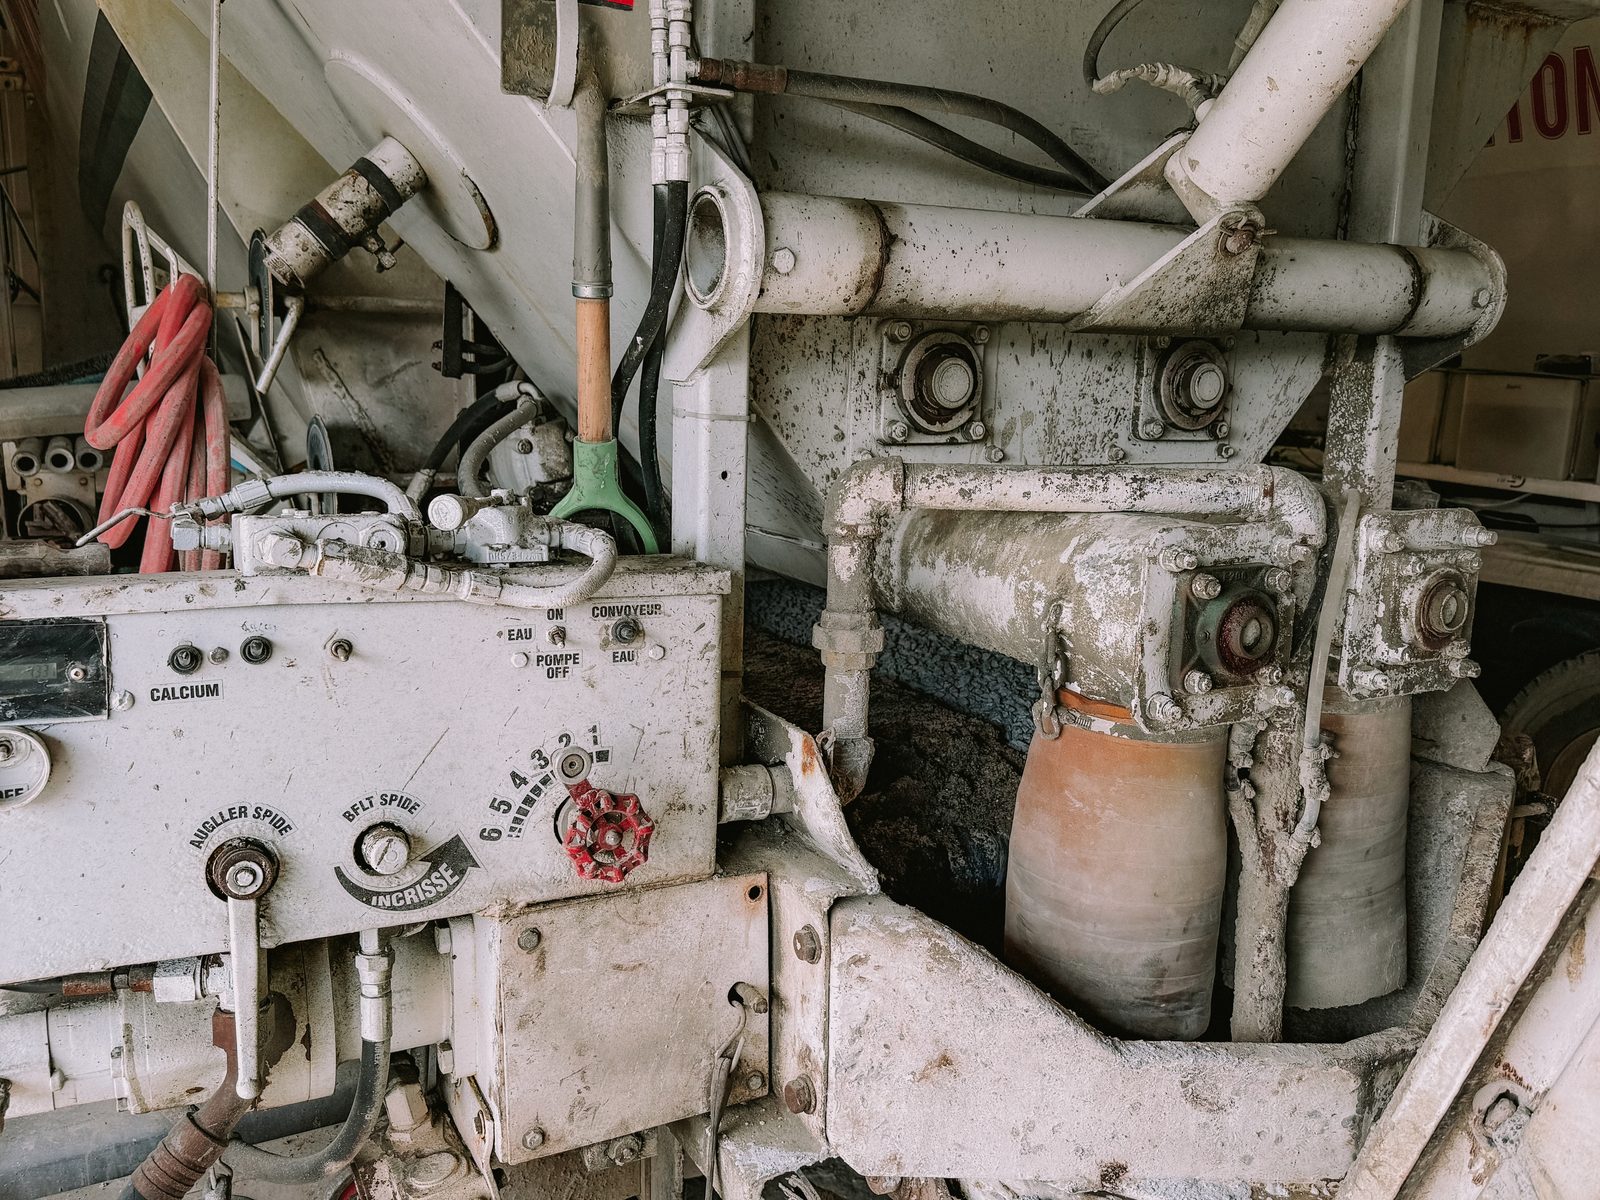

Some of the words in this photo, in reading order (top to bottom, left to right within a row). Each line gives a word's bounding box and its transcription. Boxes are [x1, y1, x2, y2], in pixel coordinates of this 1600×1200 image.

[547, 608, 564, 621] ON
[591, 603, 662, 618] CONVOYEUR
[507, 628, 532, 641] EAU
[536, 653, 580, 667] POMPE
[612, 650, 635, 663] EAU
[546, 666, 570, 679] OFF
[150, 683, 220, 702] CALCIUM
[558, 732, 572, 748] 2
[587, 724, 599, 746] 1
[530, 748, 550, 770] 3
[509, 770, 529, 790] 4
[379, 793, 421, 815] SPIDE
[489, 797, 513, 815] 5
[252, 806, 293, 836] SPIDE
[479, 827, 503, 842] 6
